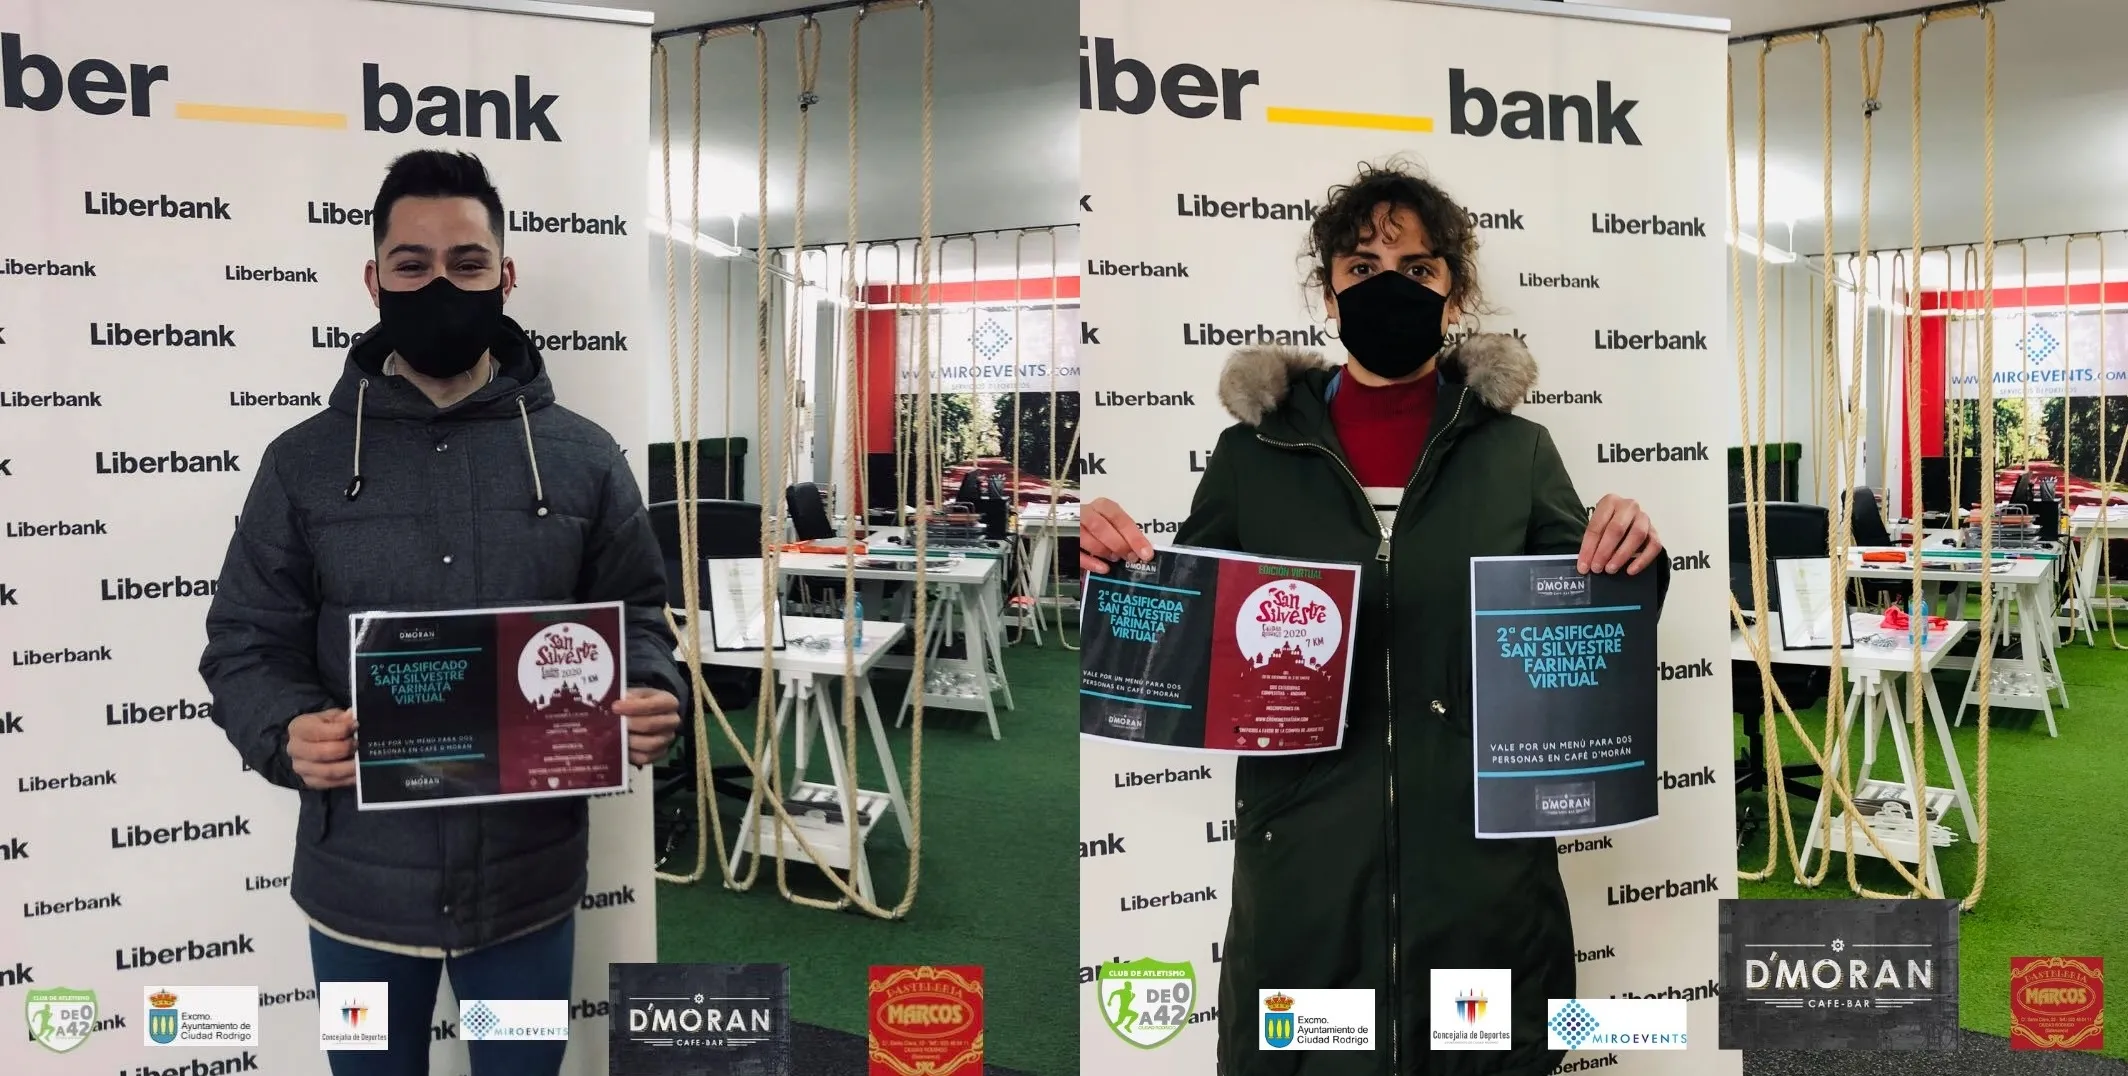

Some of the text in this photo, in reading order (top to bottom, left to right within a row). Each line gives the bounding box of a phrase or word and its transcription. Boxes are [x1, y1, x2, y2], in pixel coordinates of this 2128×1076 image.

[0, 32, 563, 143] ber bank
[1080, 35, 1644, 147] iber bank
[84, 191, 231, 221] Liberbank
[308, 201, 374, 226] Liber
[1177, 193, 1320, 221] Liberbank
[509, 210, 628, 236] Liberbank
[1592, 212, 1707, 237] Liberbank
[225, 265, 318, 283] Liberbank
[1088, 259, 1189, 278] Liberbank
[1519, 272, 1600, 289] Liberbank
[90, 322, 237, 347] Liberbank
[1183, 323, 1327, 347] Liberbank
[1594, 329, 1708, 351] Liberbank
[1, 391, 103, 407] Liberbank
[230, 391, 322, 407] Liberbank
[1095, 391, 1196, 407] Liberbank
[96, 450, 241, 474] Liberbank
[1597, 441, 1710, 465] Liberbank
[7, 519, 108, 538] Liberbank
[1291, 568, 1322, 580] VIRTUAL
[1537, 579, 1585, 591] D'MORAN
[1111, 592, 1184, 613] CLASIFICADA
[1271, 588, 1300, 610] San
[1098, 601, 1181, 624] SAN SILVESTRE
[1256, 600, 1327, 626] Silvestre
[1110, 615, 1166, 633] FARINATA
[1283, 628, 1307, 639] 2020
[1520, 623, 1626, 642] CLASIFICADA
[1112, 626, 1158, 643] VIRTUAL
[1305, 637, 1325, 648] 7 KM
[13, 646, 113, 666] Liberbank
[1500, 638, 1622, 659] SAN SILVESTRE
[388, 659, 468, 674] CLASIFICADO
[1524, 655, 1607, 673] FARINATA
[374, 670, 465, 686] SAN SILVESTRE
[391, 681, 452, 695] FARINATA
[1082, 669, 1098, 678] VALE
[1100, 672, 1112, 680] POR
[1146, 680, 1165, 690] PARA
[1167, 682, 1182, 691] DOS
[1082, 678, 1115, 690] PERSONAS
[1117, 683, 1125, 692] EN
[1528, 671, 1599, 689] VIRTUAL
[395, 692, 446, 704] VIRTUAL
[106, 699, 213, 726] Liberba
[1490, 734, 1633, 752] VALE POR UN MENÚ PARA DOS
[1492, 746, 1632, 764] PERSONAS EN CAFÉ D'MORÁN
[18, 770, 117, 793] Liberbank
[1114, 764, 1213, 788] Liberbank
[1542, 797, 1591, 811] D'MORAN
[111, 815, 251, 849] Liberbank
[1557, 835, 1613, 855] erbank
[245, 874, 290, 891] Liber
[1607, 873, 1719, 907] Liberbank
[24, 893, 122, 917] Liberbank
[1120, 886, 1218, 912] Liberbank
[116, 933, 255, 970] Liberbank
[258, 987, 317, 1008] iberba
